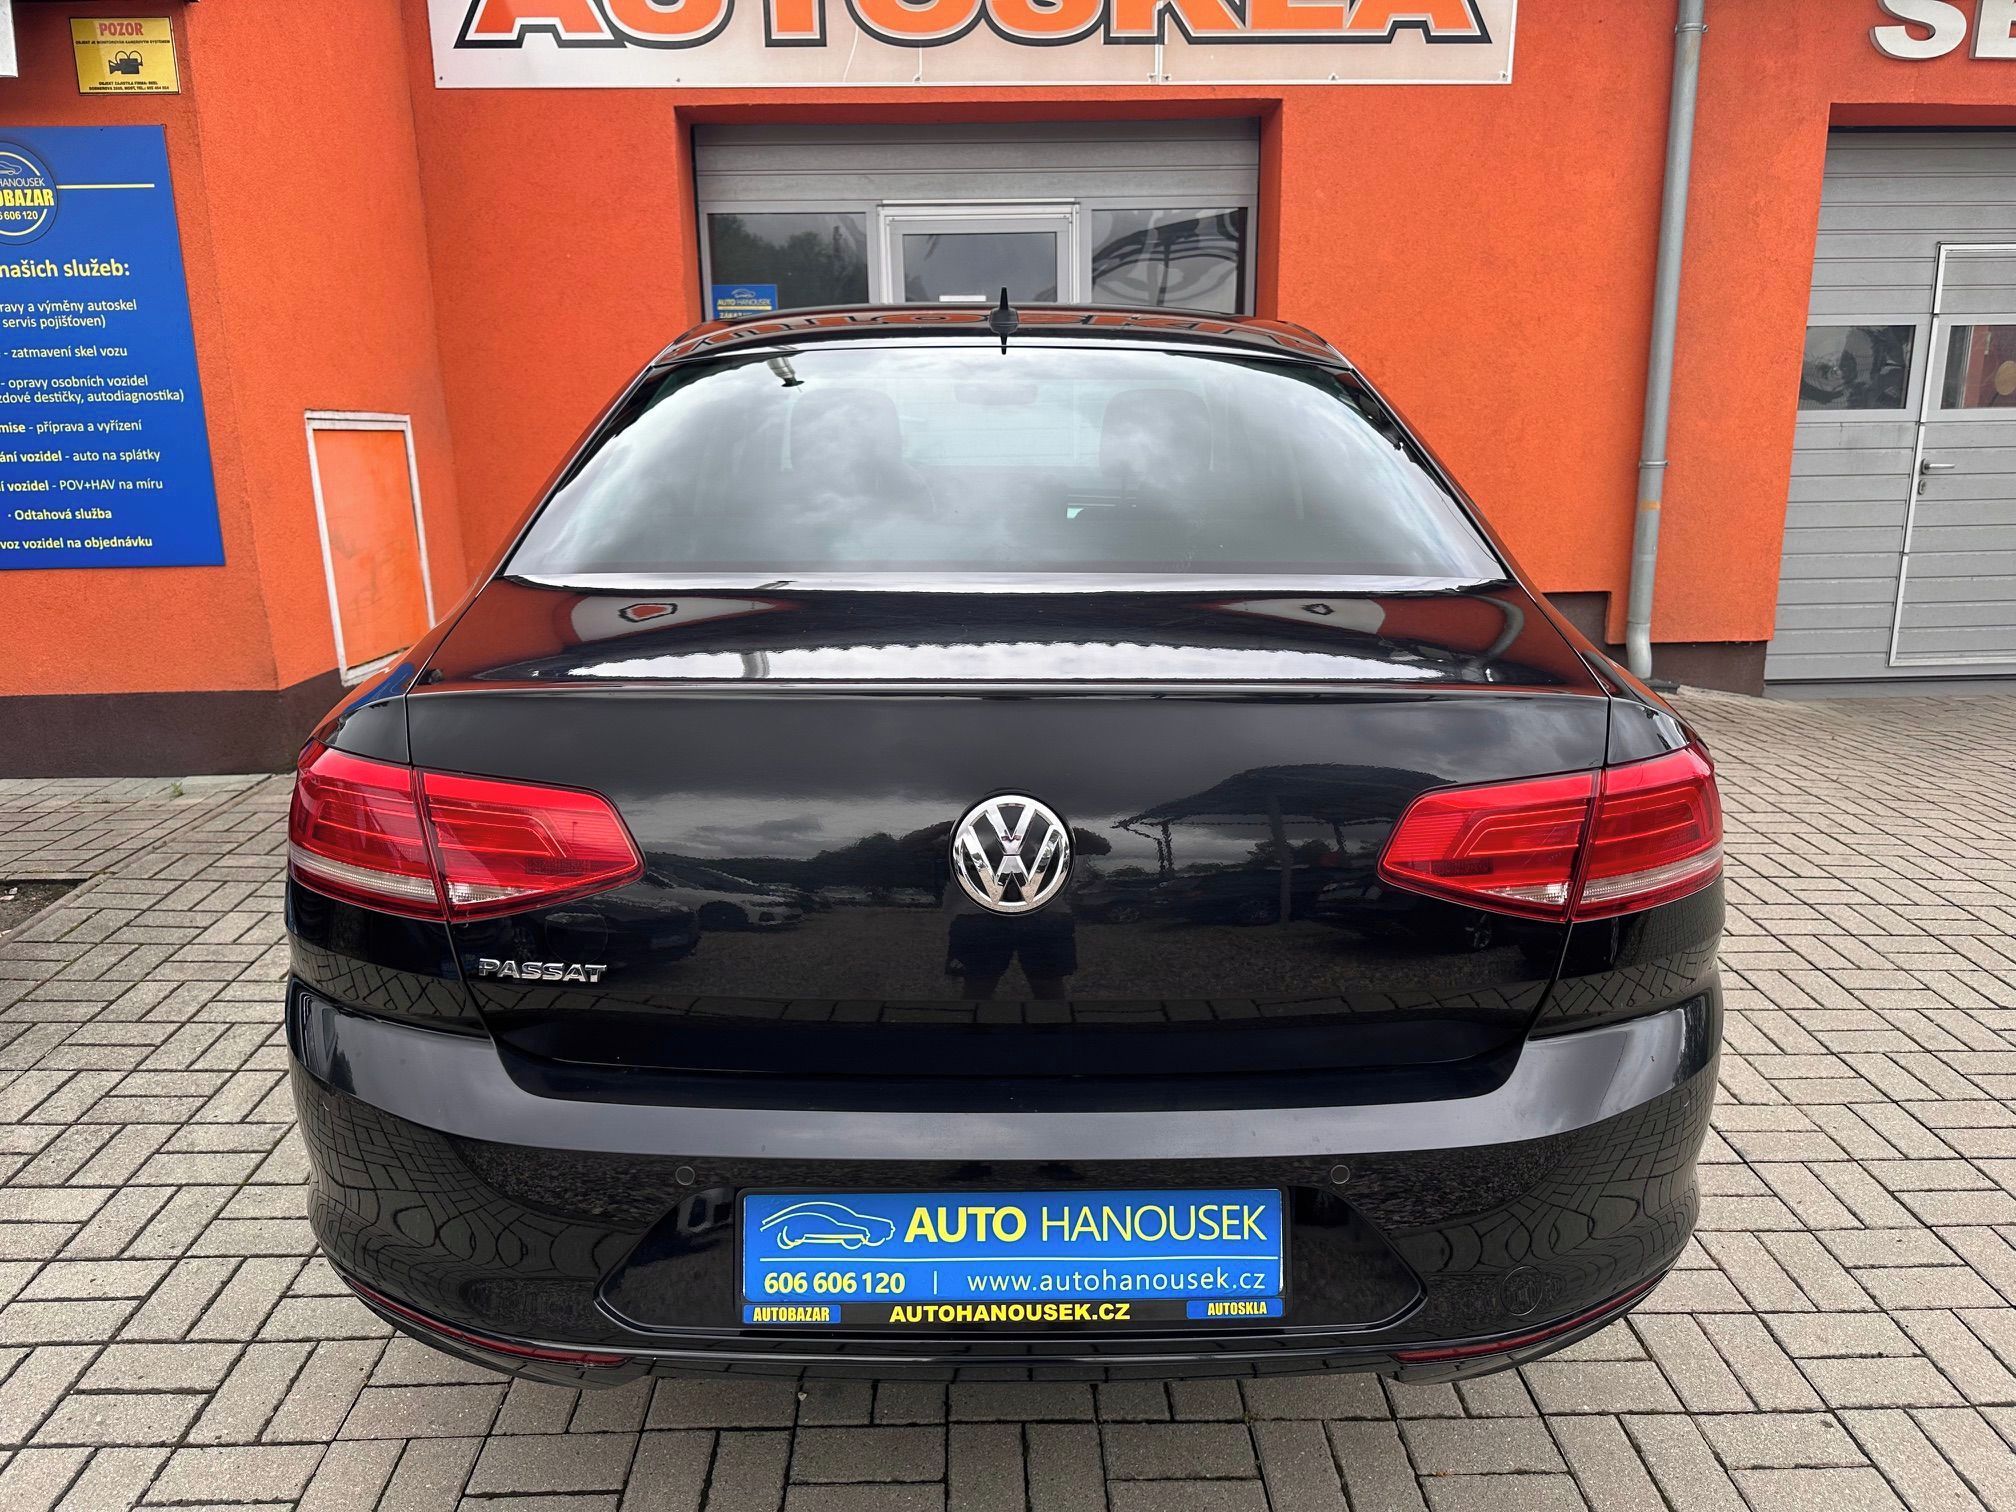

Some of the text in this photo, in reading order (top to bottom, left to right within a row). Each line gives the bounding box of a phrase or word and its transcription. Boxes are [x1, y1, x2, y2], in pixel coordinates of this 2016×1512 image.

[99, 22, 144, 36] POZOR
[22, 211, 38, 220] 120
[0, 258, 130, 278] našich služeb:
[27, 303, 35, 312] a
[37, 300, 84, 315] výměny
[88, 299, 137, 312] autoskel
[2, 315, 106, 329] servis pojišťoven)
[11, 346, 72, 358] zatmavení
[75, 346, 97, 357] skel
[100, 347, 128, 356] vozu
[8, 379, 48, 391] opravy
[51, 376, 104, 388] osobních
[107, 374, 149, 387] vozidel
[34, 390, 84, 404] destičky,
[36, 420, 84, 435] příprava
[87, 423, 94, 432] a
[97, 419, 142, 433] vyřízení
[20, 450, 62, 462] vozidel
[72, 451, 100, 461] auto
[102, 453, 117, 461] na
[119, 449, 160, 463] splátky
[7, 480, 49, 491] vozidel
[59, 479, 115, 491] POV+HAV
[119, 481, 133, 490] na
[136, 478, 163, 489] míru
[14, 508, 113, 520] Odtahová služba
[22, 537, 64, 549] vozidel
[67, 540, 81, 548] na
[84, 536, 153, 551] objednávku
[478, 958, 607, 983] PASSAT
[904, 1205, 1267, 1242] AUTO HANOUSEK
[764, 1267, 1266, 1294] 606 606 120 www.autohanousek.cz
[753, 1301, 1267, 1323] AUTOBAZAR AUTOHANOUSEK.CZ AUTOSKLA
